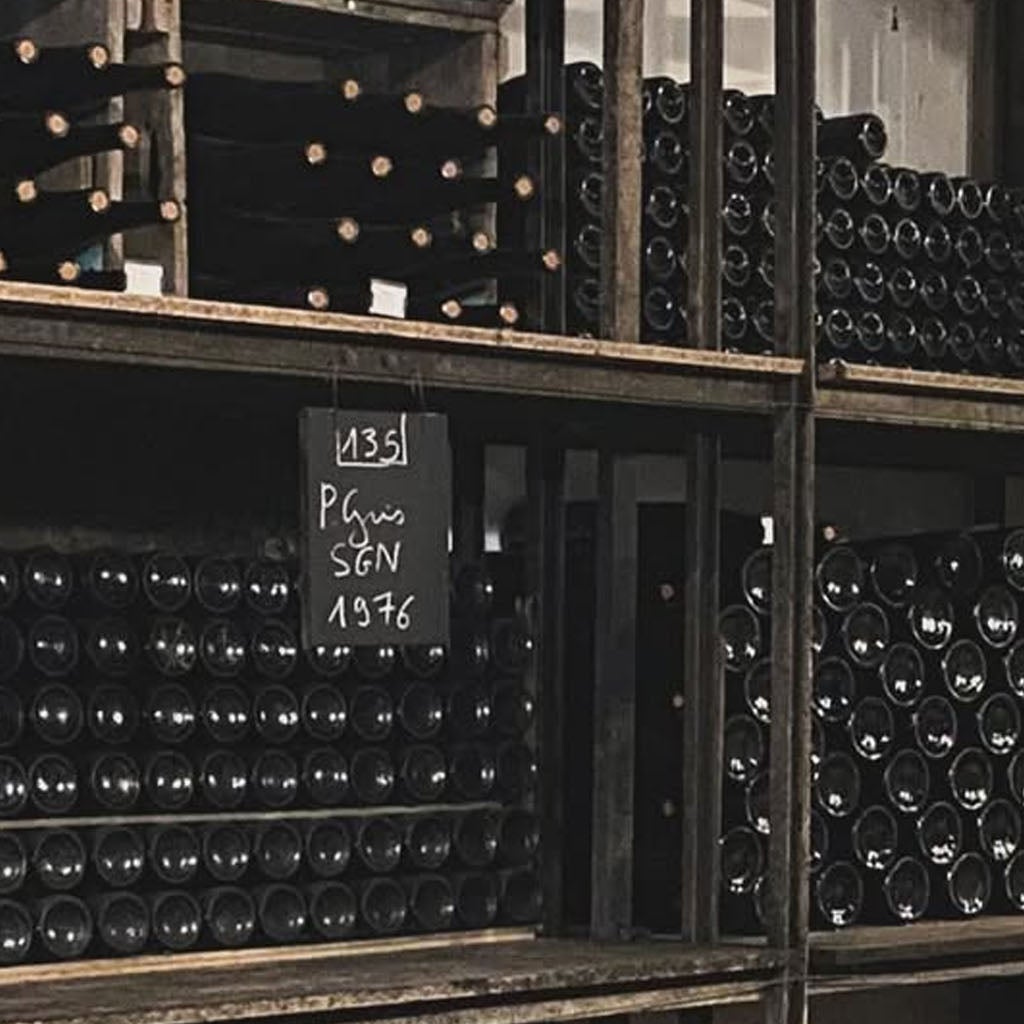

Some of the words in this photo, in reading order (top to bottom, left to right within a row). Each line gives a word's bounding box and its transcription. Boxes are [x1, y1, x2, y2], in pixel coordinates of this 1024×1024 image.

[341, 427, 401, 464] 135
[320, 482, 338, 530] P
[330, 541, 401, 577] SGN
[328, 591, 415, 630] 1976
